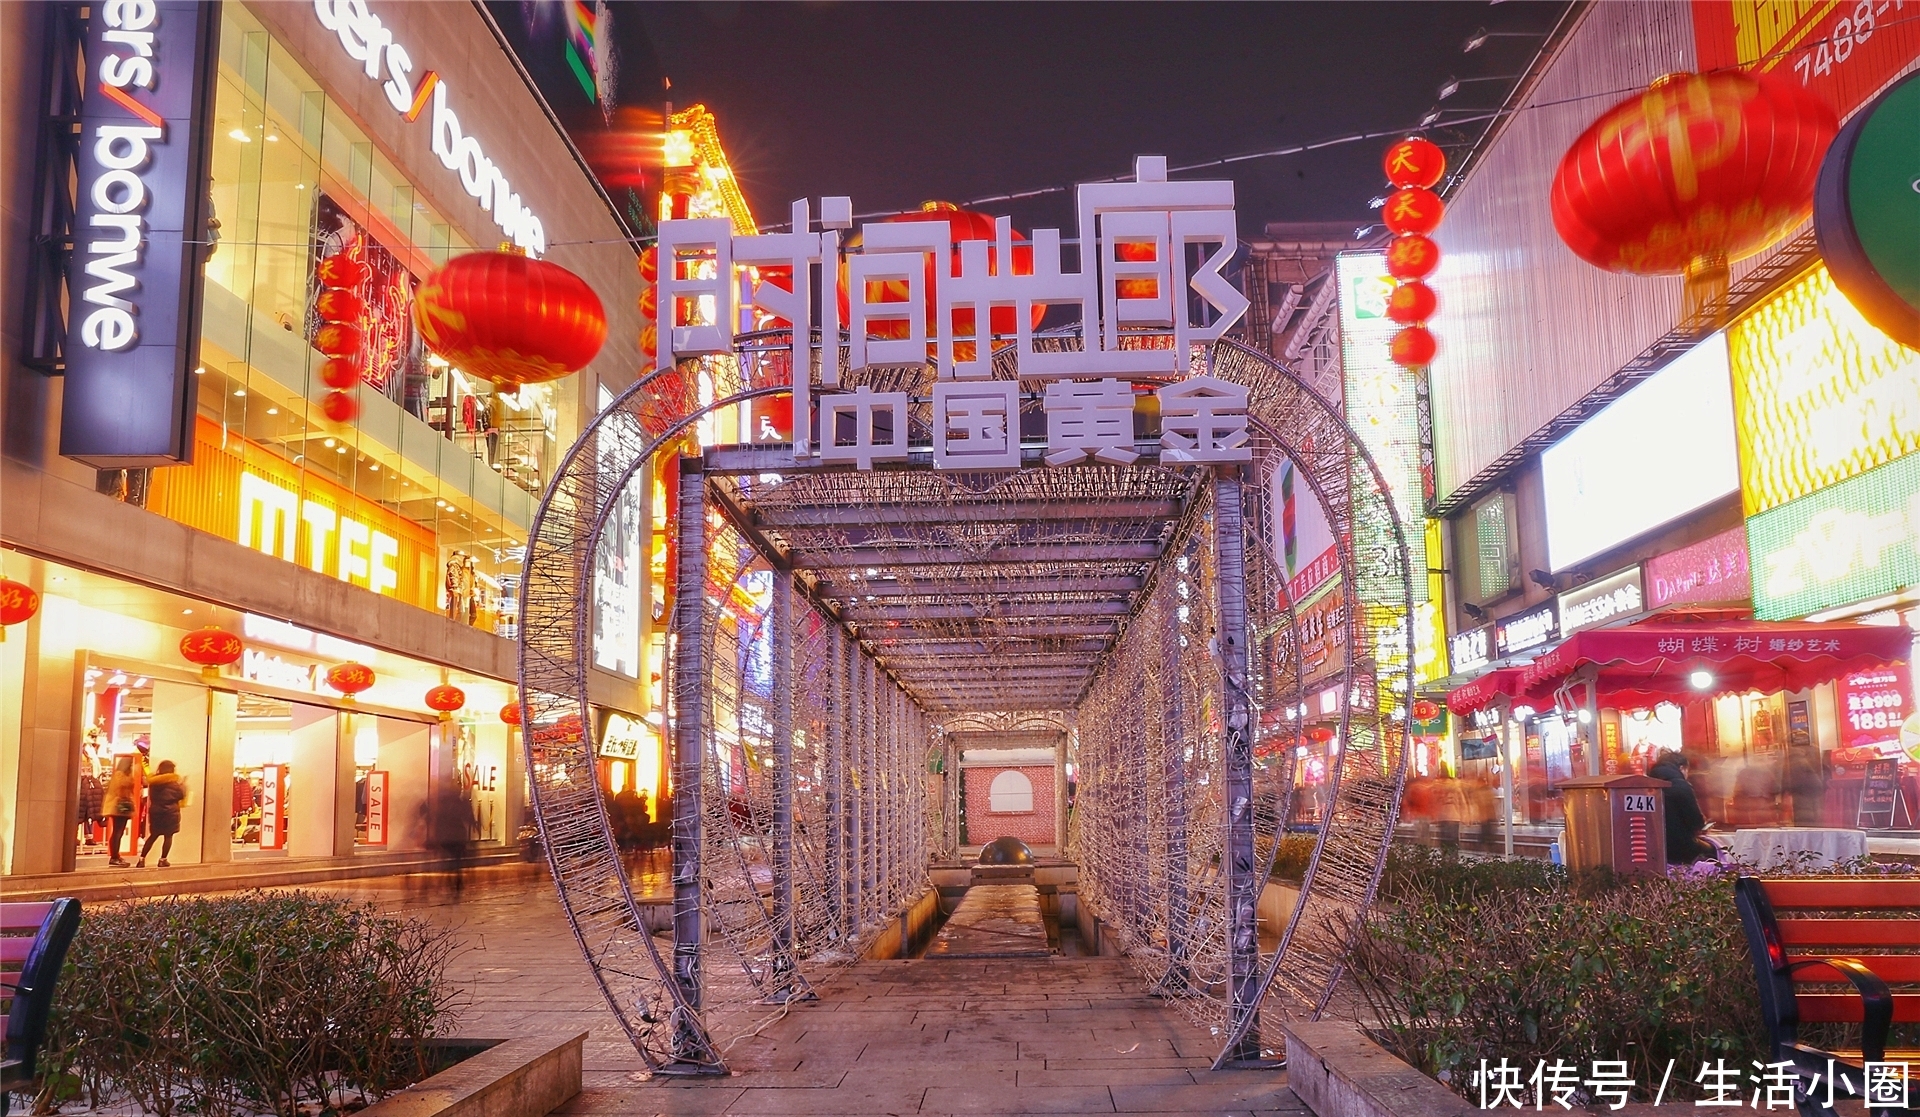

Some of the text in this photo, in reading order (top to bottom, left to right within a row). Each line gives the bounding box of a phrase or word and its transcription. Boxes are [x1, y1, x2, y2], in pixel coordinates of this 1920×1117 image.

[819, 374, 1253, 471] 中国黄金
[1768, 638, 1841, 652] 婚纱艺术
[1849, 711, 1888, 731] 188
[463, 763, 497, 792] SALE
[264, 780, 276, 833] SALE
[370, 785, 382, 831] SALE
[1625, 796, 1655, 811] 24K
